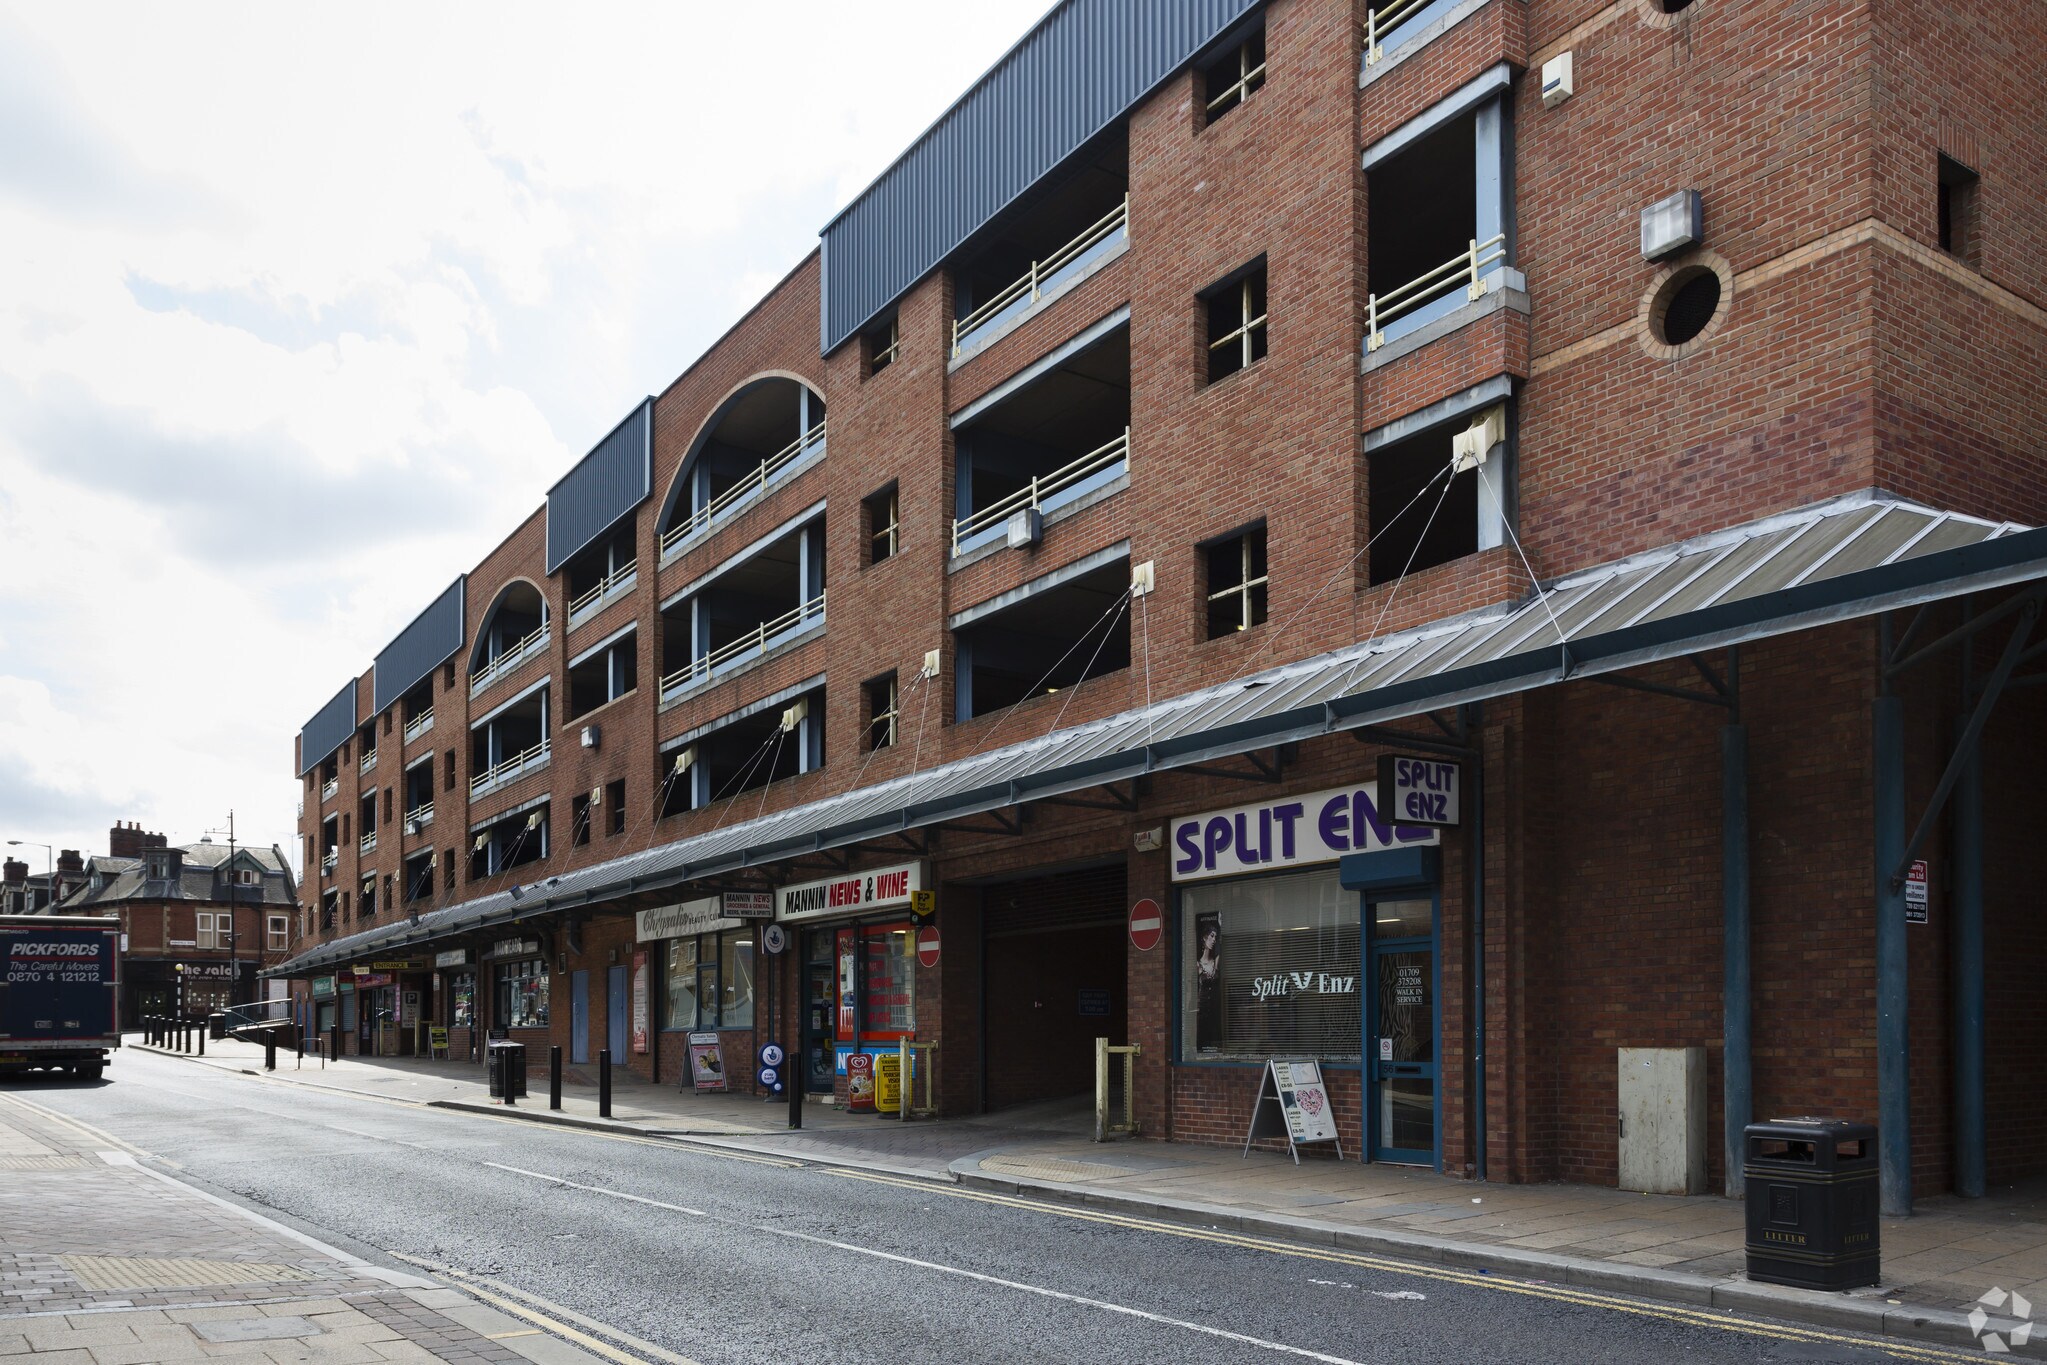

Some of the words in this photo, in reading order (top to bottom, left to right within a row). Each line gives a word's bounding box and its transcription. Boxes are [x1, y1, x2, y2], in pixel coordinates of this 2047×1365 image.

[1398, 760, 1454, 793] SPLIT
[1406, 792, 1448, 822] ENZ
[1176, 801, 1304, 874] SPLIT
[1916, 871, 1924, 880] Ltd
[785, 886, 827, 914] MANNIN
[829, 879, 861, 907] NEWS
[865, 877, 874, 902] &
[877, 870, 908, 899] WINE
[726, 893, 750, 902] MANNIN
[753, 895, 770, 903] NEWS
[689, 915, 707, 925] BEAUTY
[709, 912, 722, 922] CLIN
[10, 943, 100, 956] PICKFORDS
[10, 961, 28, 971] The
[31, 961, 62, 971] Careful
[66, 962, 100, 971] Movers
[180, 963, 201, 975] he
[7, 972, 41, 982] 0870
[46, 972, 55, 981] 4
[60, 972, 100, 982] 121212
[1399, 968, 1420, 977] 01709
[1397, 977, 1422, 986] 375208
[1251, 974, 1290, 1002] Split
[1318, 973, 1354, 994] Enz
[1396, 988, 1415, 996] WALK
[407, 993, 416, 1003] P
[1396, 995, 1423, 1003] SERVICE
[1383, 1064, 1394, 1074] 56
[1764, 1231, 1806, 1245] LITTER
[1844, 1232, 1871, 1245] LITTER
